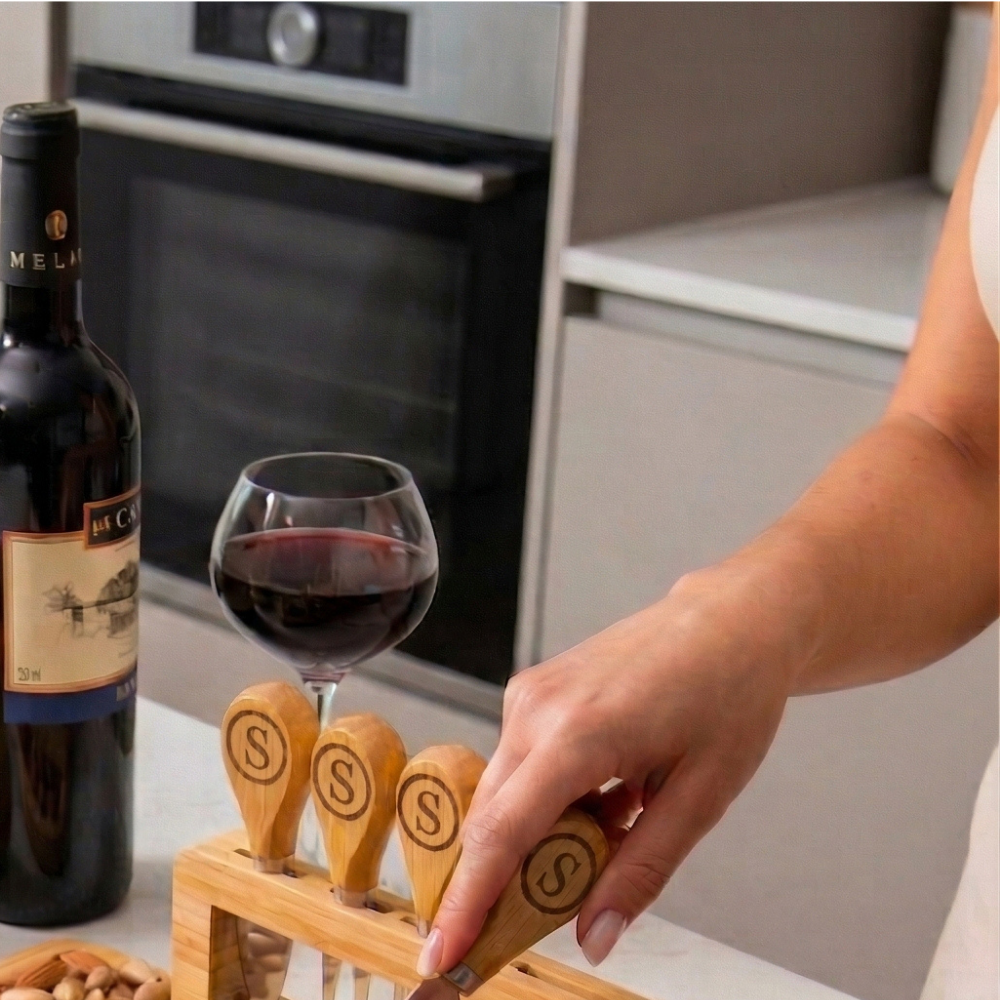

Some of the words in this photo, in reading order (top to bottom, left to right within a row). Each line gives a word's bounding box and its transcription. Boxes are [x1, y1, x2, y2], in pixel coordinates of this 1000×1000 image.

[245, 725, 270, 771] S
[329, 759, 355, 806] S
[416, 790, 441, 836] S
[536, 852, 582, 898] S
